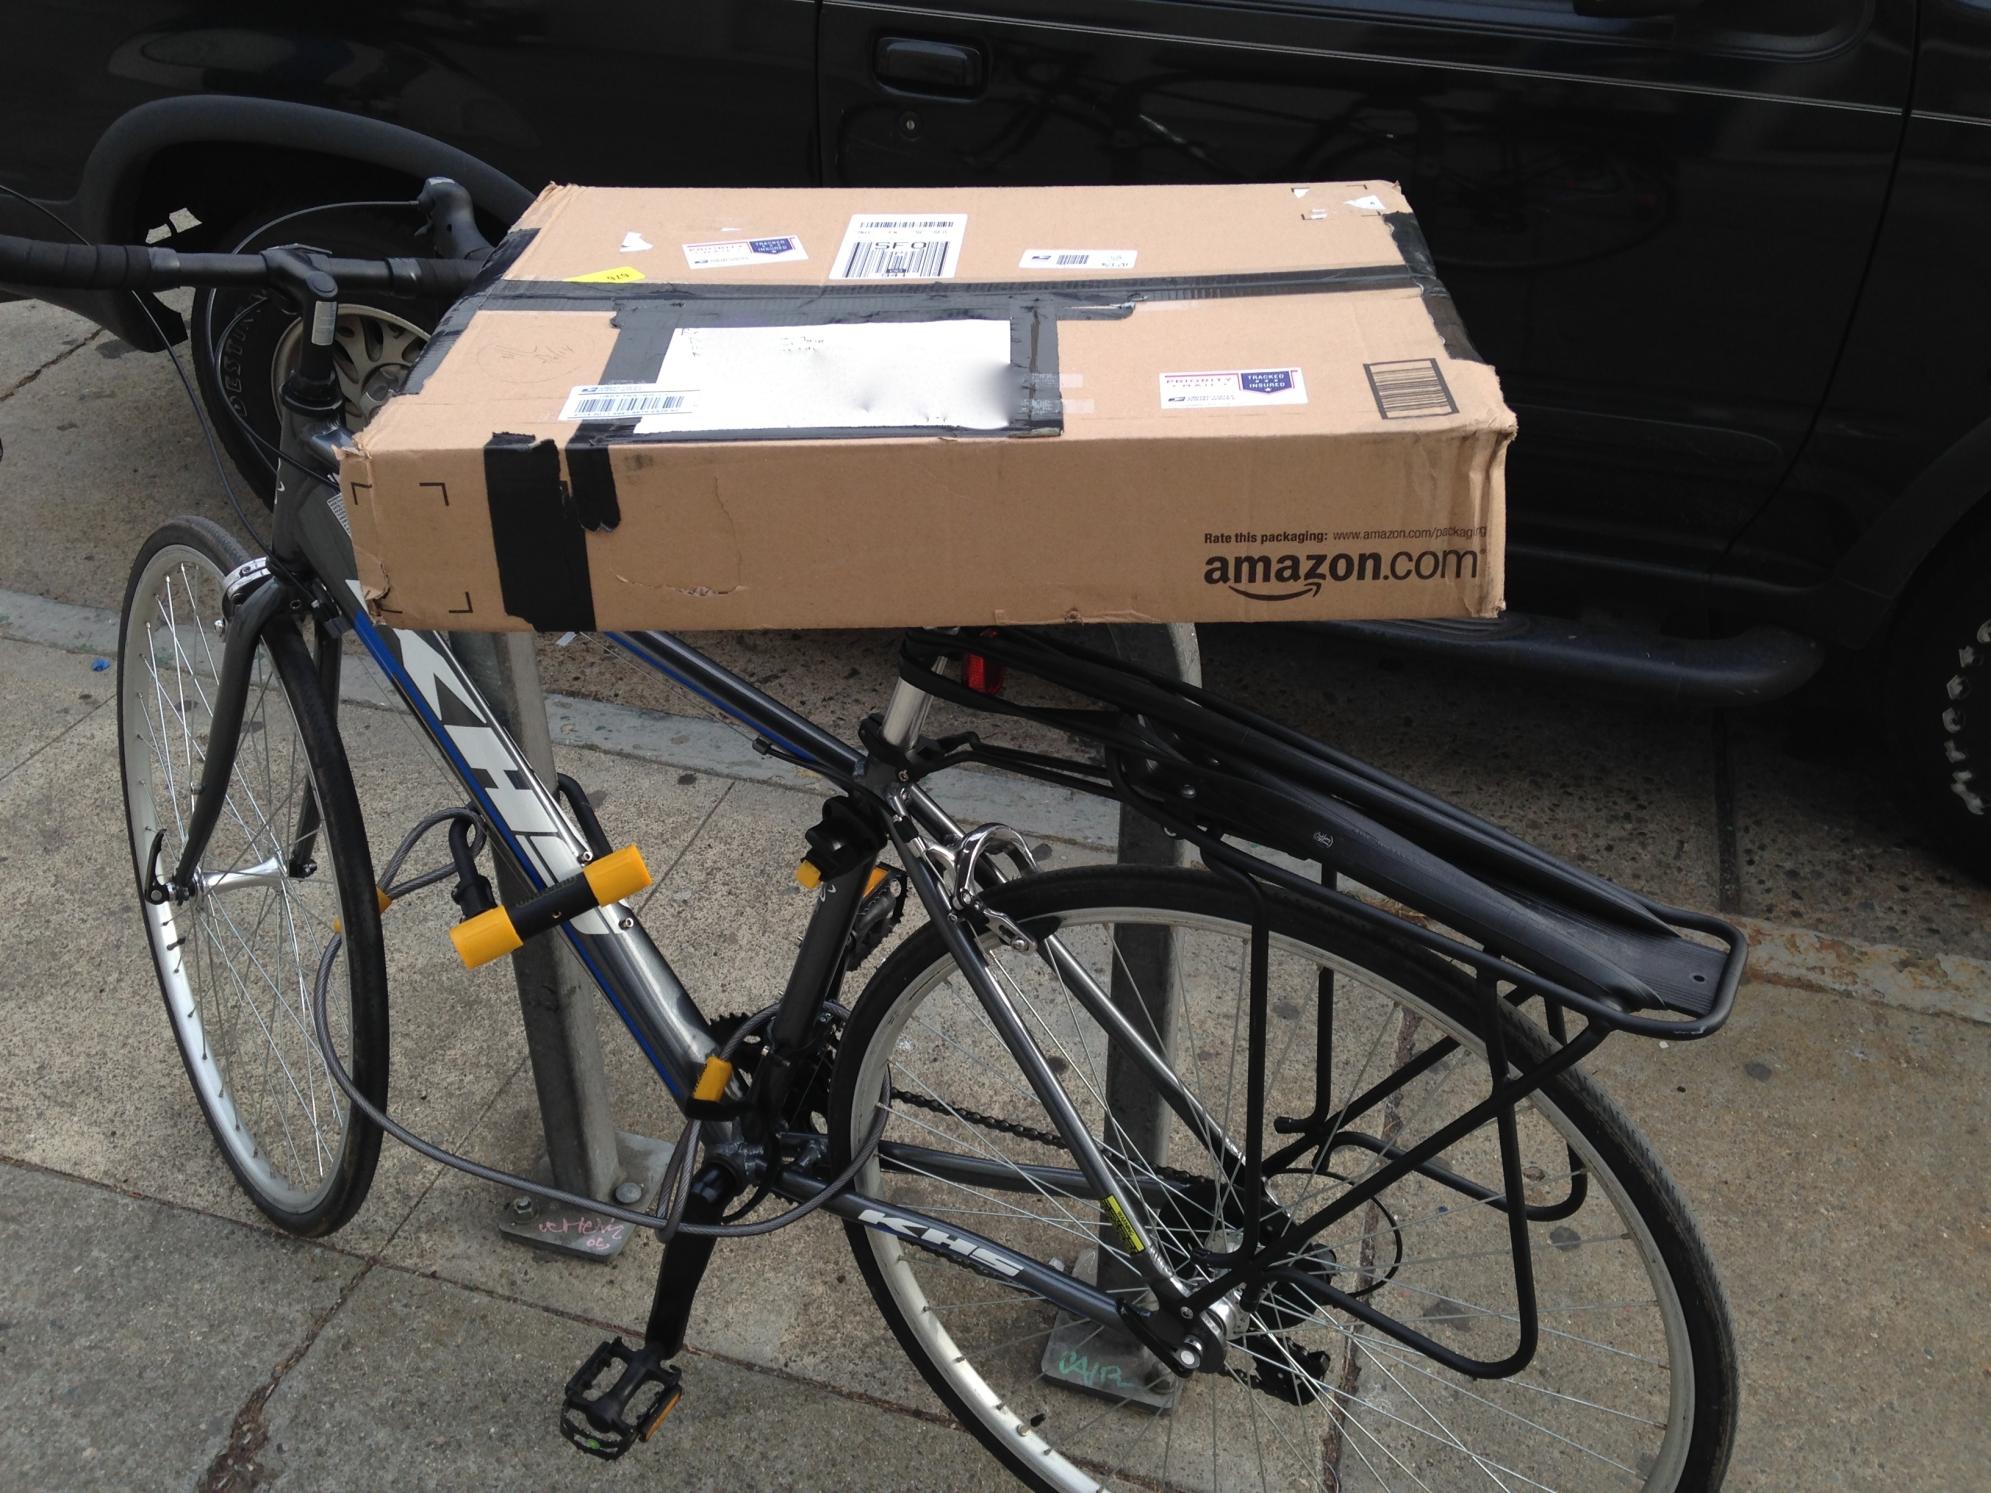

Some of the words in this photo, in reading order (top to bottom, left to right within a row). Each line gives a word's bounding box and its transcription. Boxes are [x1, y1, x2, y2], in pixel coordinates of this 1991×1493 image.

[1204, 532, 1232, 544] Rate
[1234, 531, 1258, 543] this
[1260, 530, 1328, 544] packaging:
[1332, 526, 1487, 541] www.amazon.com/packaging
[1203, 549, 1478, 585] amazon.com
[858, 1209, 1025, 1277] KHS
